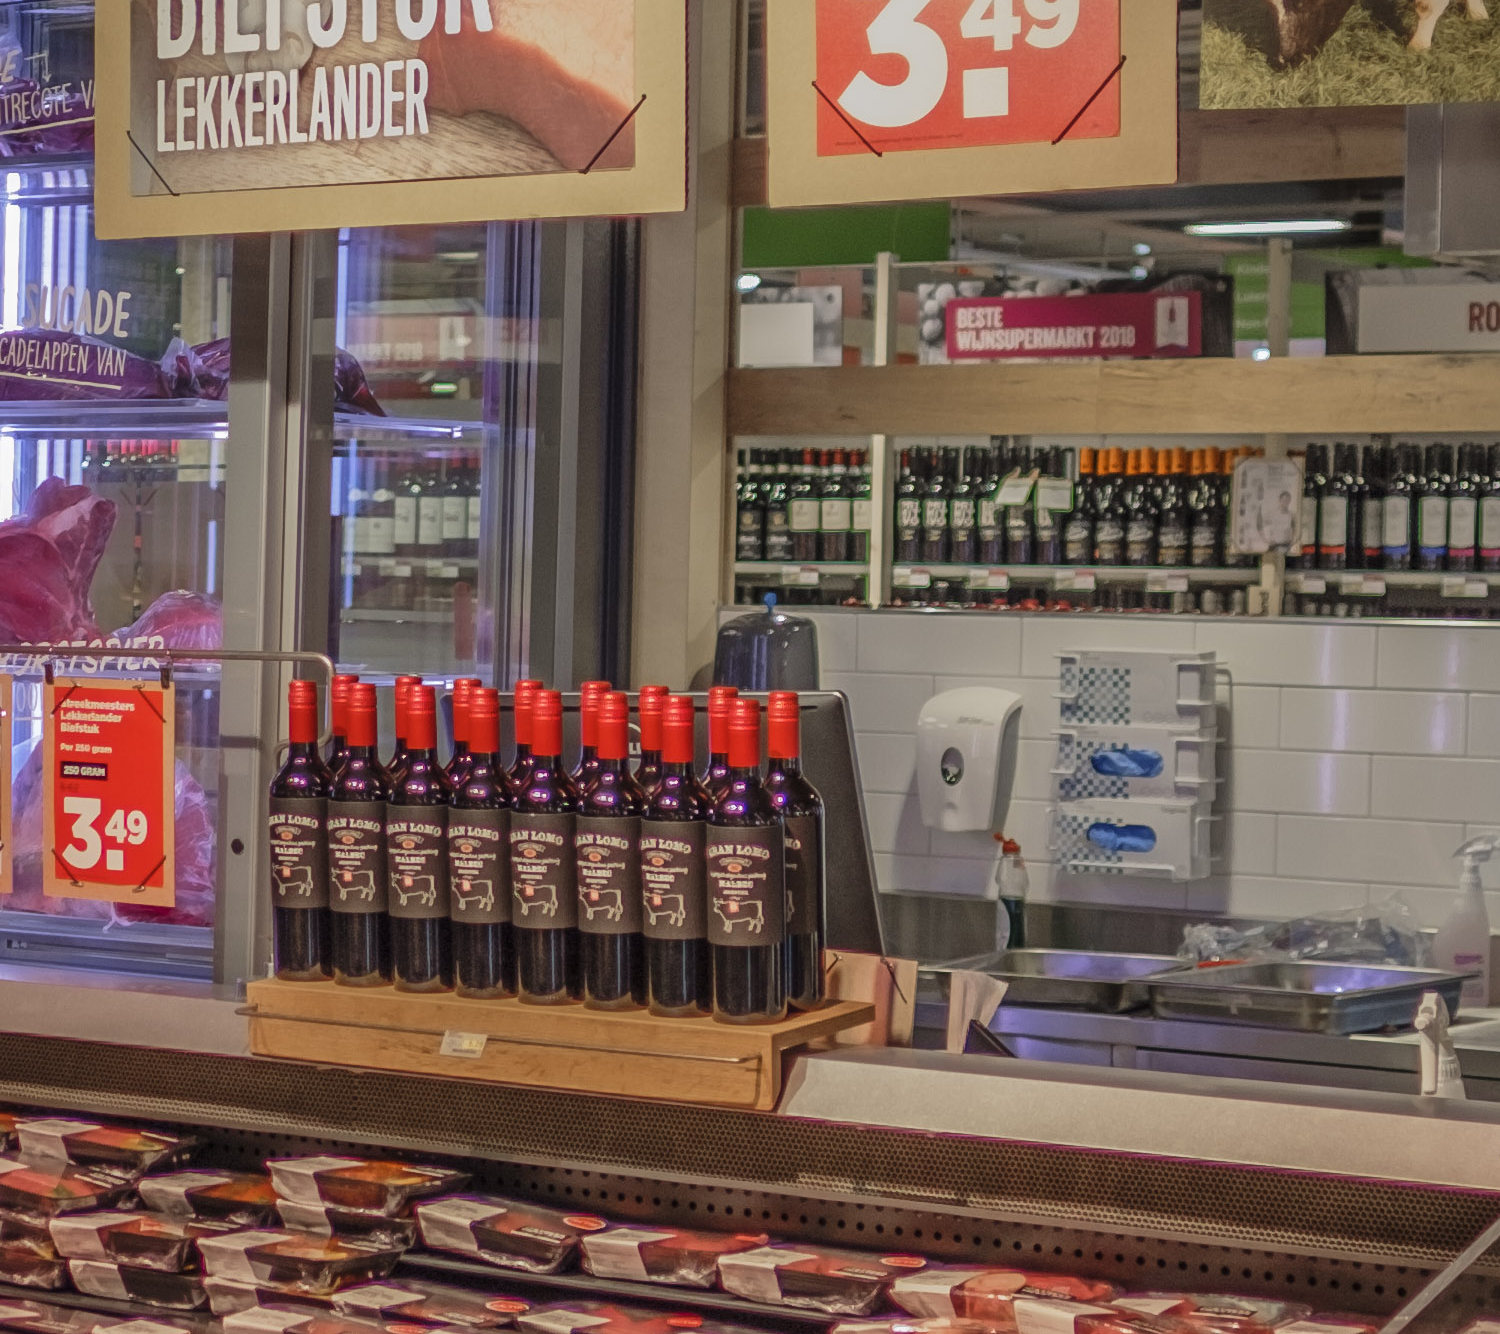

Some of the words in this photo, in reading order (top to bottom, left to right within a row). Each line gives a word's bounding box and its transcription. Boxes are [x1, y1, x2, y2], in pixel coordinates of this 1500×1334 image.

[156, 58, 429, 153] LEKKERLANDER
[22, 283, 132, 337] SUCADE
[956, 306, 1004, 329] BESTE
[956, 325, 1096, 352] WIJNSUPERMARKT
[1100, 325, 1136, 348] 2018
[97, 346, 128, 377] VAN
